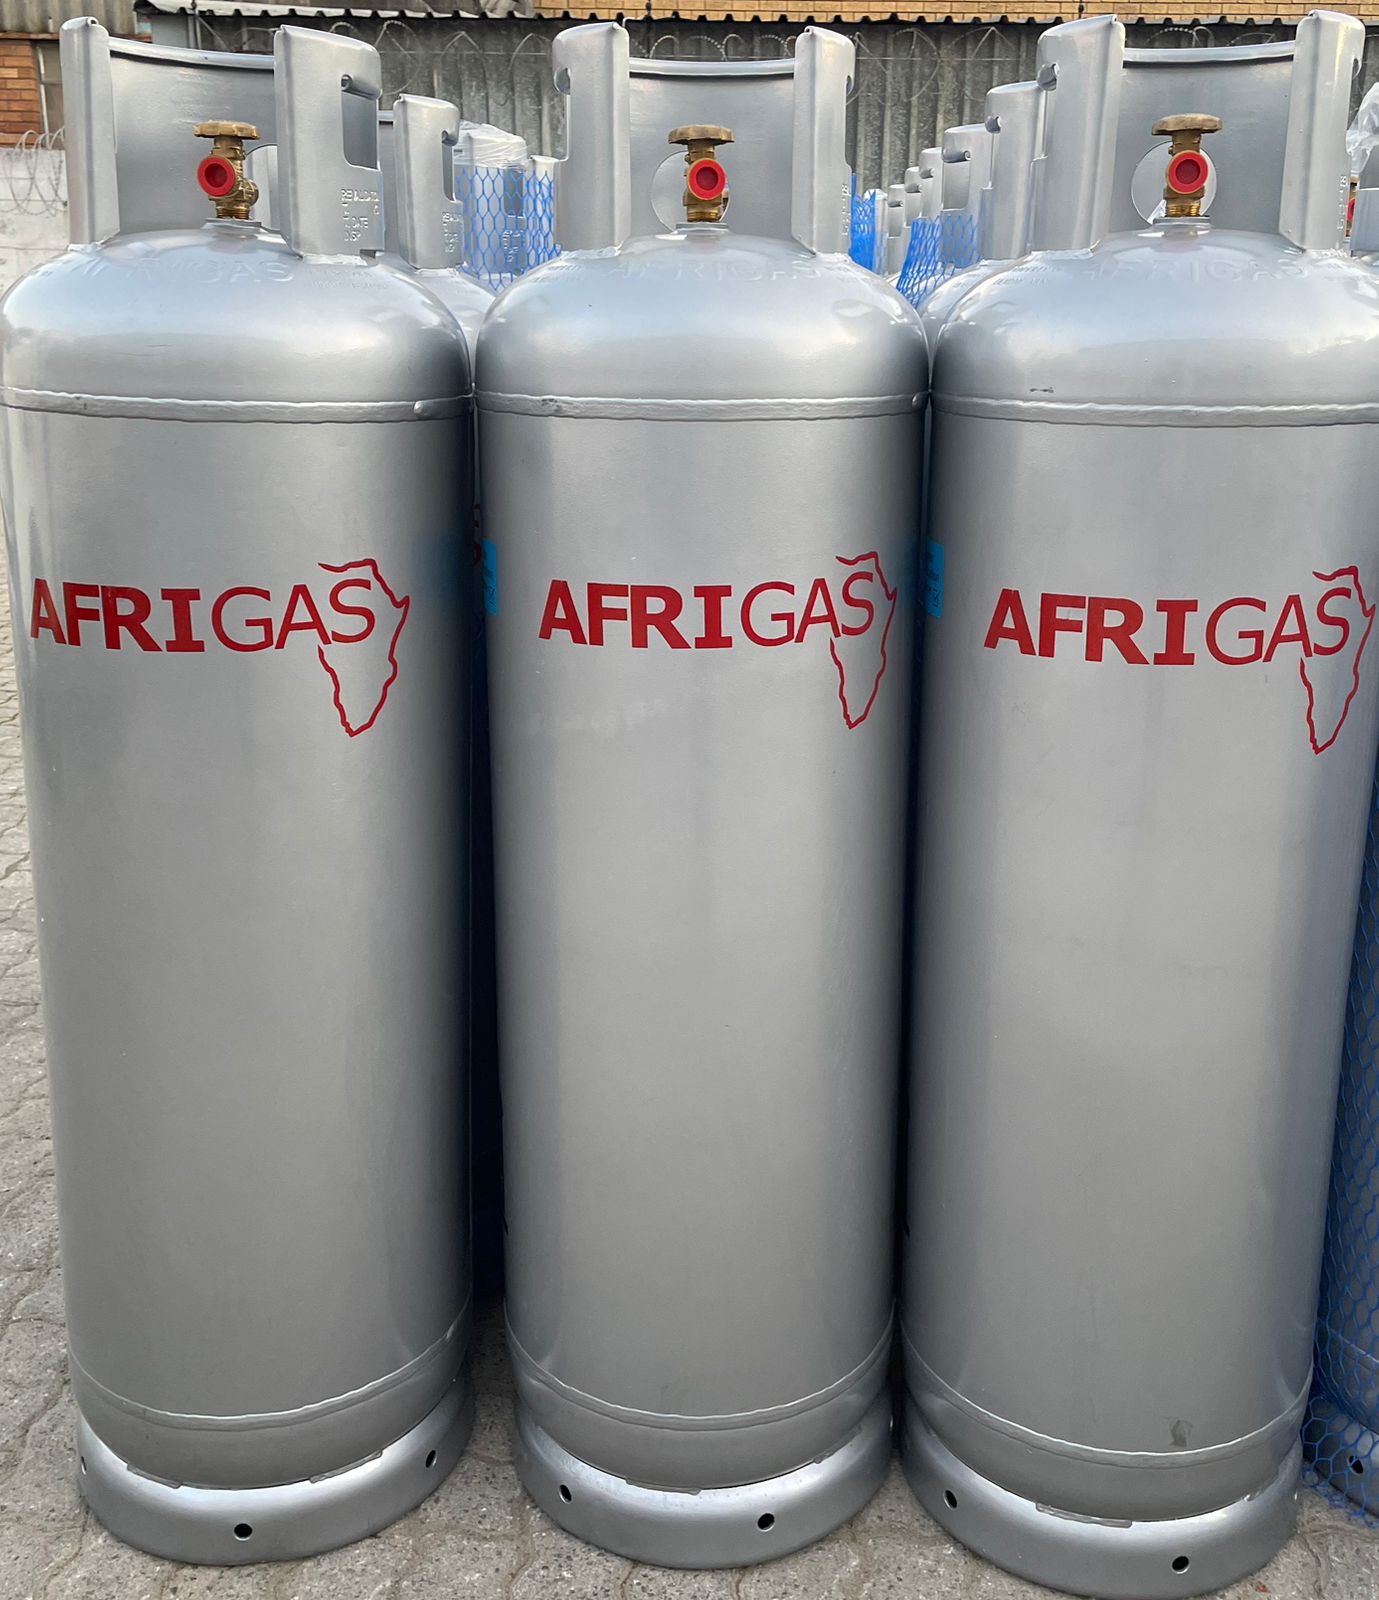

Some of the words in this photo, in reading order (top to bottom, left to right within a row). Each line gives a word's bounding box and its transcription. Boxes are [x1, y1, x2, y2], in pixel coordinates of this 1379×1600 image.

[30, 577, 376, 653] AFRIGAS
[538, 571, 875, 650] AFRIGAS
[983, 587, 1353, 666] AFRIGAS
